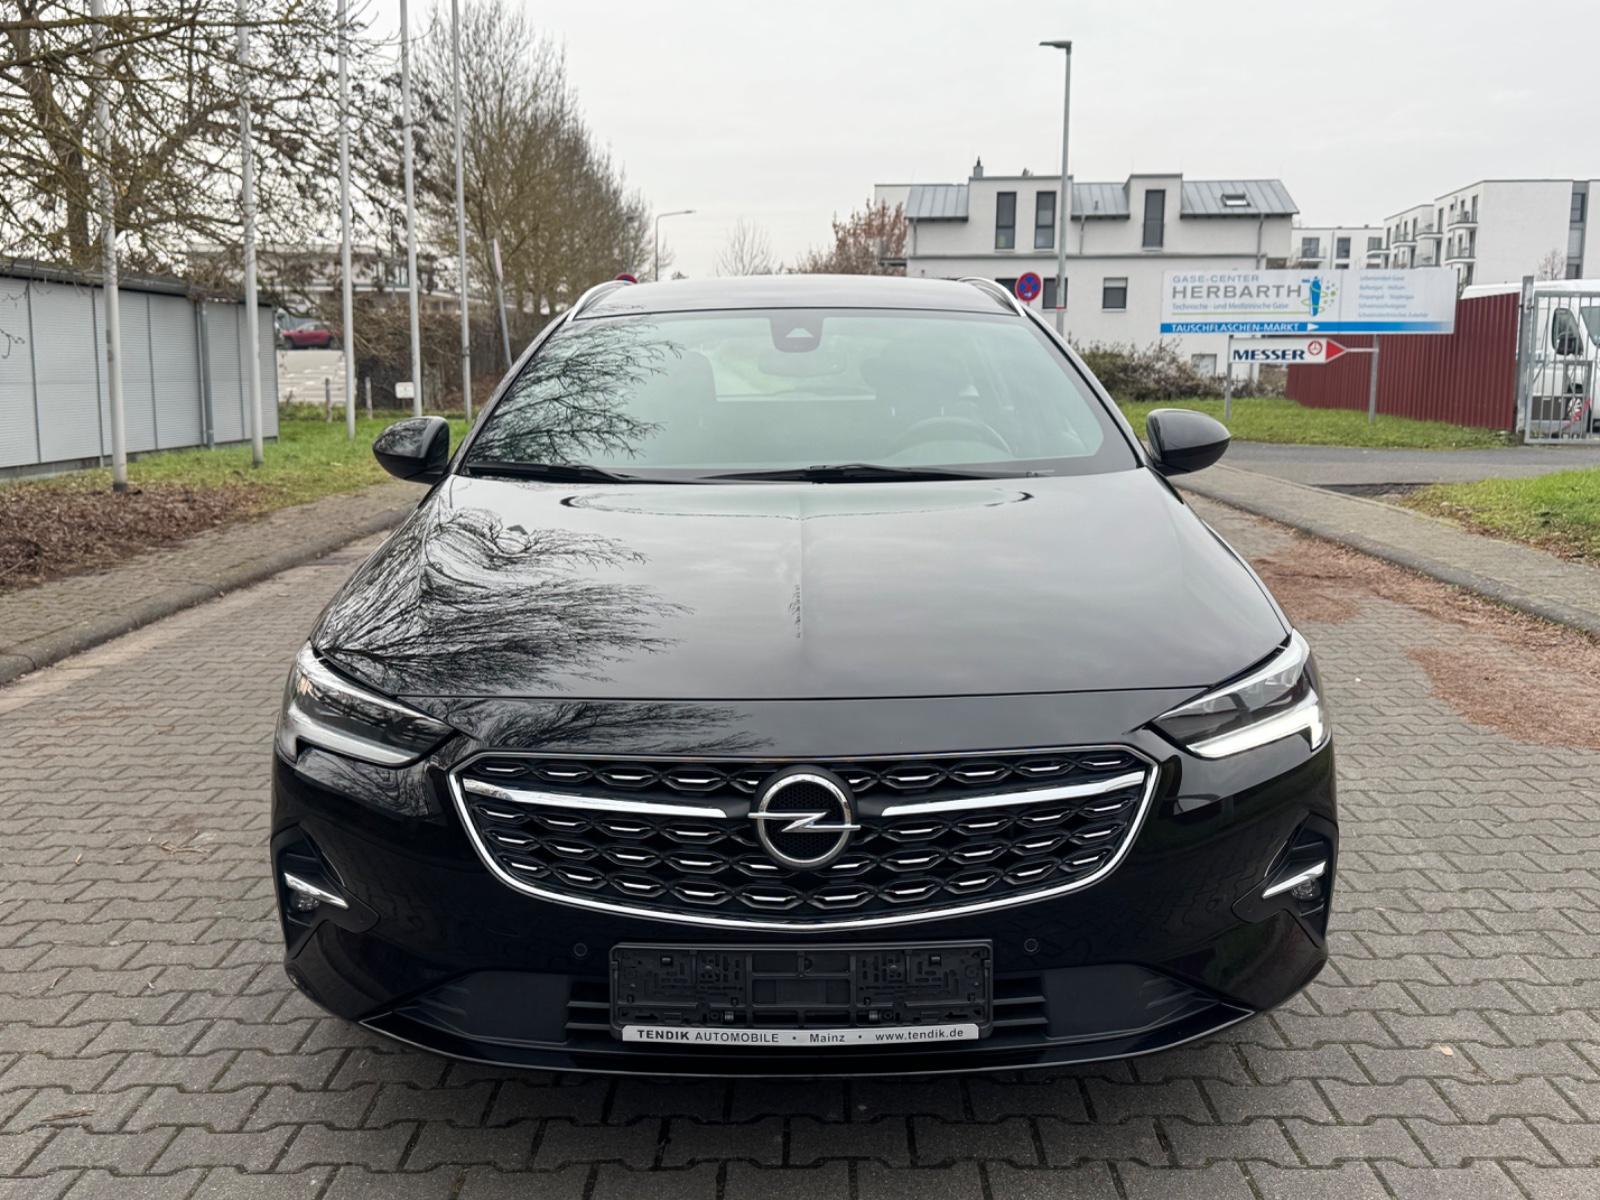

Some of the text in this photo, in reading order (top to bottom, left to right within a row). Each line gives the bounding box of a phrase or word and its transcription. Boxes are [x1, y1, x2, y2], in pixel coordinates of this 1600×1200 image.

[1172, 274, 1259, 284] GASE-CENTER
[1172, 285, 1301, 299] HERBARTH
[1171, 323, 1299, 332] TAUSCHFLASCHEN-MARKT
[1233, 348, 1305, 360] MESSER
[637, 1028, 964, 1043] TENDIK AUTOMOBILE Mainz www.tendik.de
